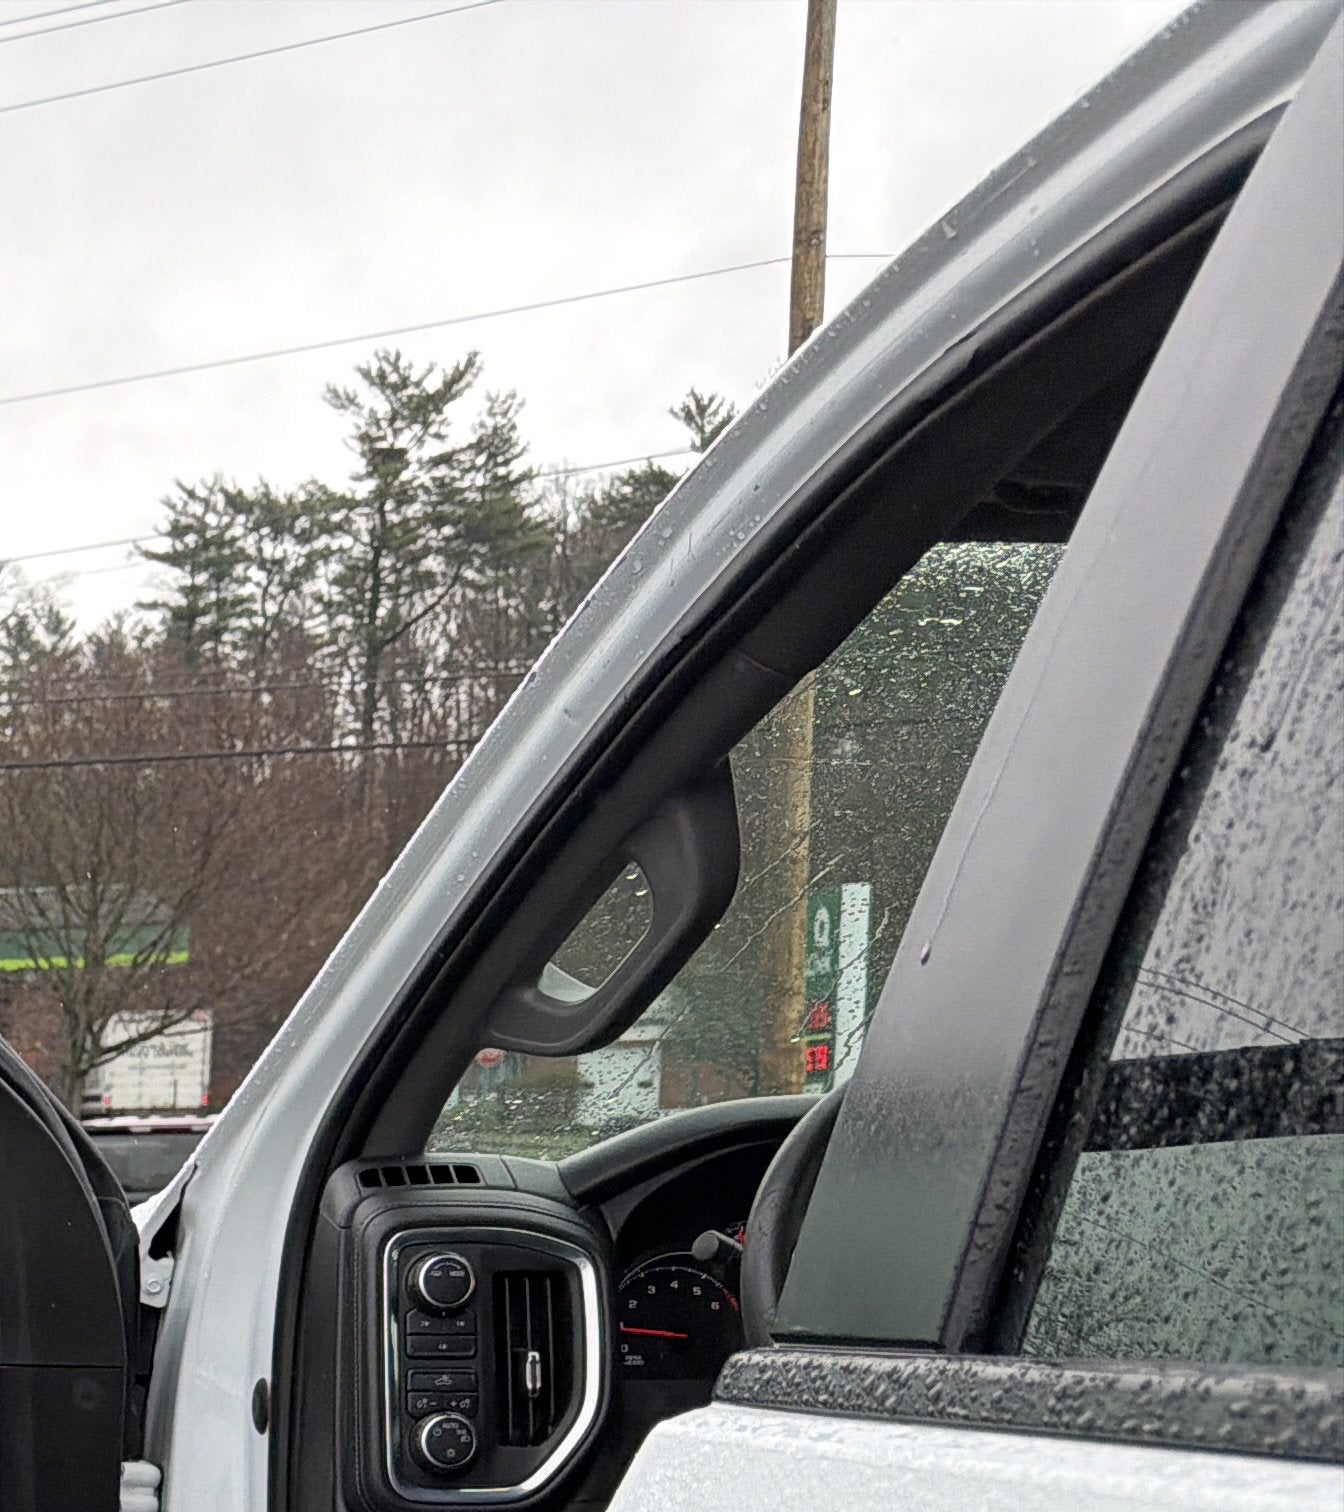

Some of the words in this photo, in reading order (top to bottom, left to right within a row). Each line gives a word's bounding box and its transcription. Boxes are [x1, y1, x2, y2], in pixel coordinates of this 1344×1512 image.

[647, 1285, 656, 1294] 3
[669, 1281, 678, 1289] 4
[692, 1286, 702, 1295] 5
[628, 1300, 638, 1309] 2
[711, 1301, 720, 1310] 6
